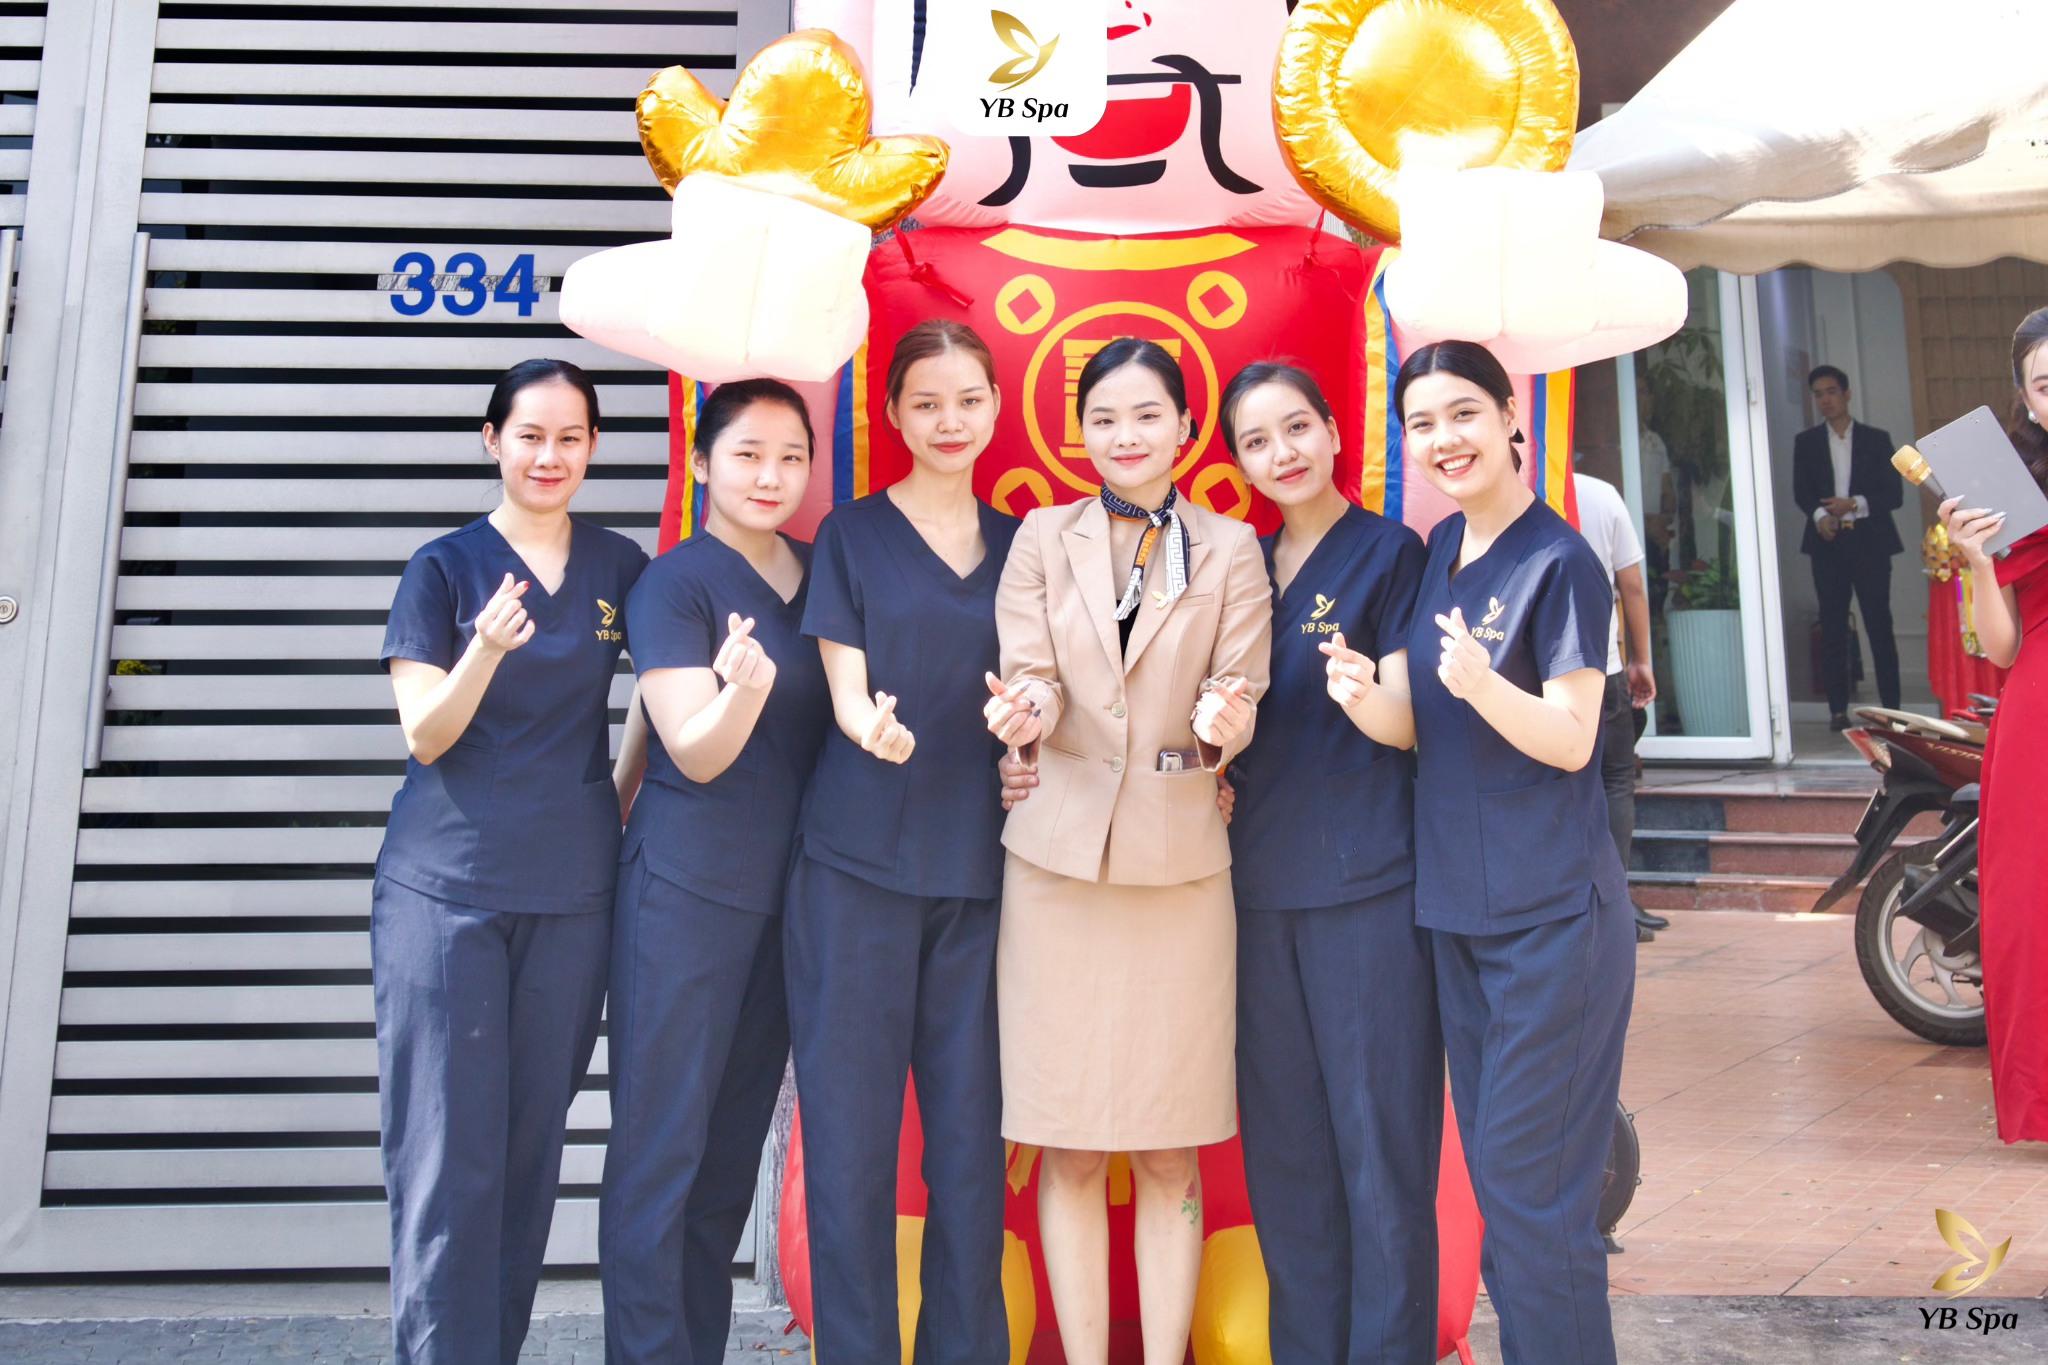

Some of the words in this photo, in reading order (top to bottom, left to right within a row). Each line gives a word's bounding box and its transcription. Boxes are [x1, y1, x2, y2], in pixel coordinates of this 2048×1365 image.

[390, 252, 540, 316] 334
[595, 629, 609, 641] YB
[610, 630, 622, 643] Spa
[1301, 622, 1316, 634] YB
[1317, 621, 1340, 635] Spa
[1472, 626, 1484, 639] YB
[1484, 627, 1505, 642] Spa
[1926, 742, 1984, 761] VISIO
